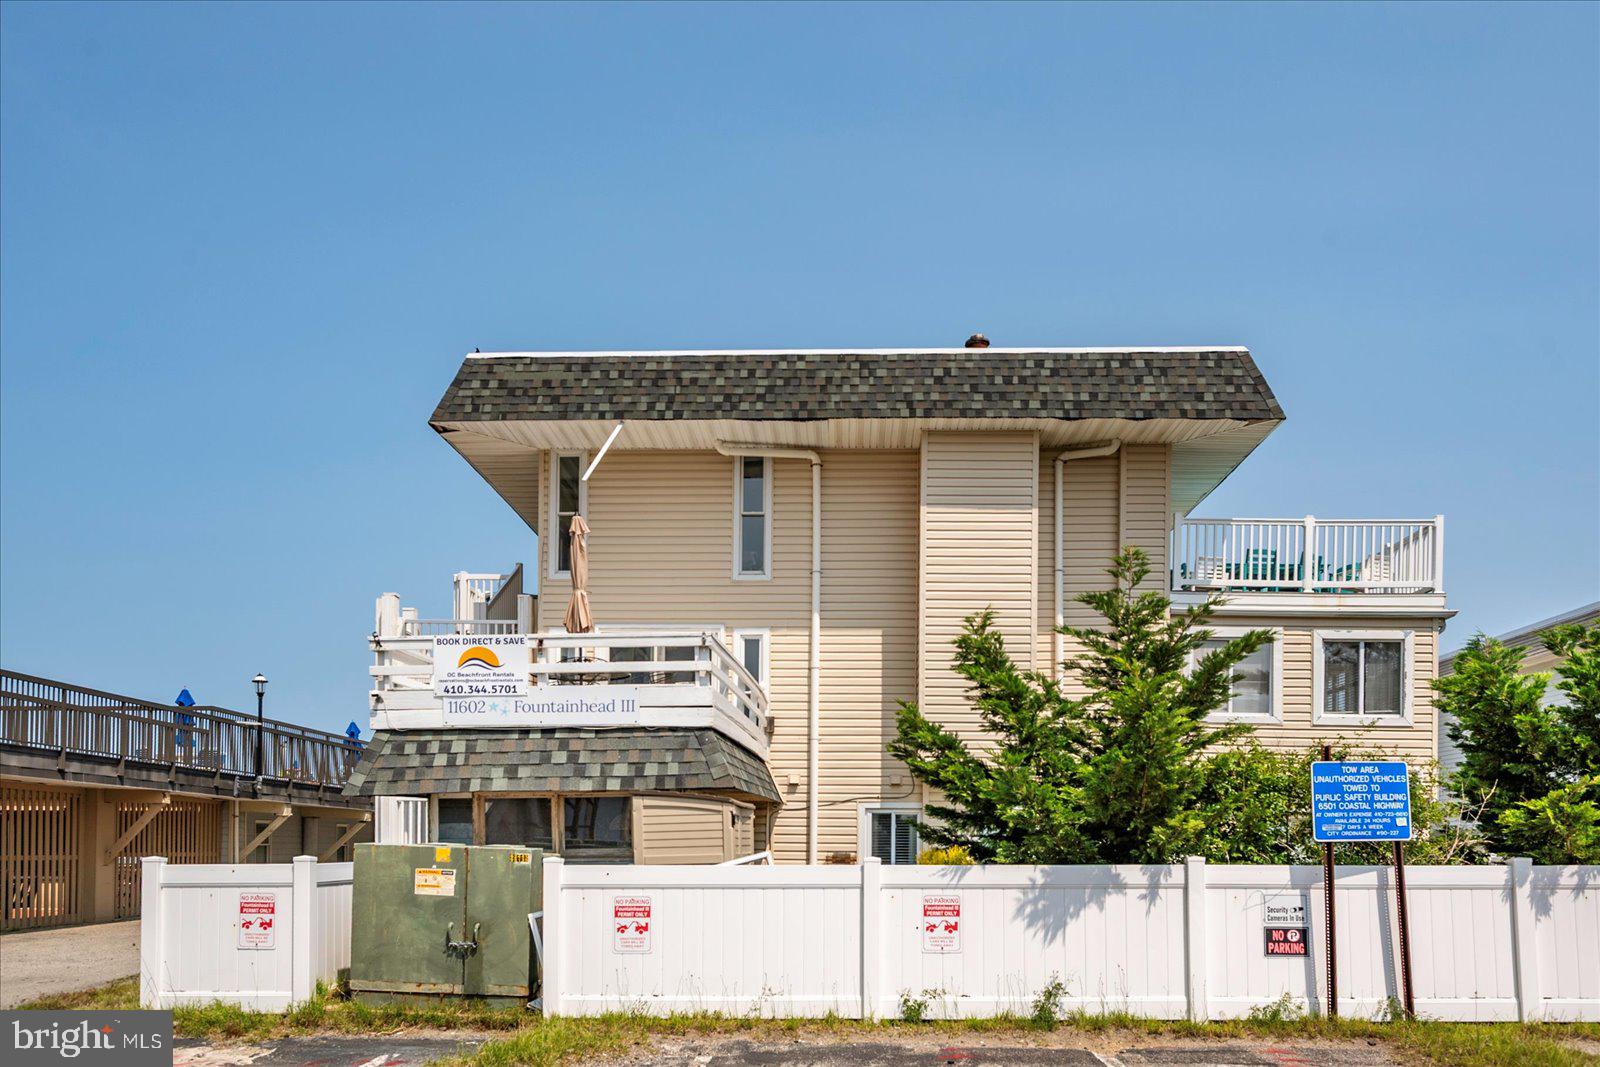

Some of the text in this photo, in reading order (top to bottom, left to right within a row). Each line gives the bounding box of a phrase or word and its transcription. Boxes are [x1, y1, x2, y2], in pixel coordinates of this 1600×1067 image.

[436, 637, 525, 645] BOOK DIRECT & SAVE
[443, 685, 518, 694] 410.344.5701
[448, 699, 636, 714] 11602 Fountainhead III
[1341, 766, 1379, 774] TOW AREA
[1314, 775, 1406, 783] UNAUTHORIZED VEHICLES
[1342, 784, 1368, 792] TOWED
[1344, 793, 1372, 801] SAFETY
[1374, 793, 1407, 801] BUILDING
[1318, 802, 1404, 810] 6501 COASTAL HIGHWAY
[1267, 906, 1288, 914] Security
[1272, 930, 1284, 941] NO
[1268, 942, 1305, 954] PARKING
